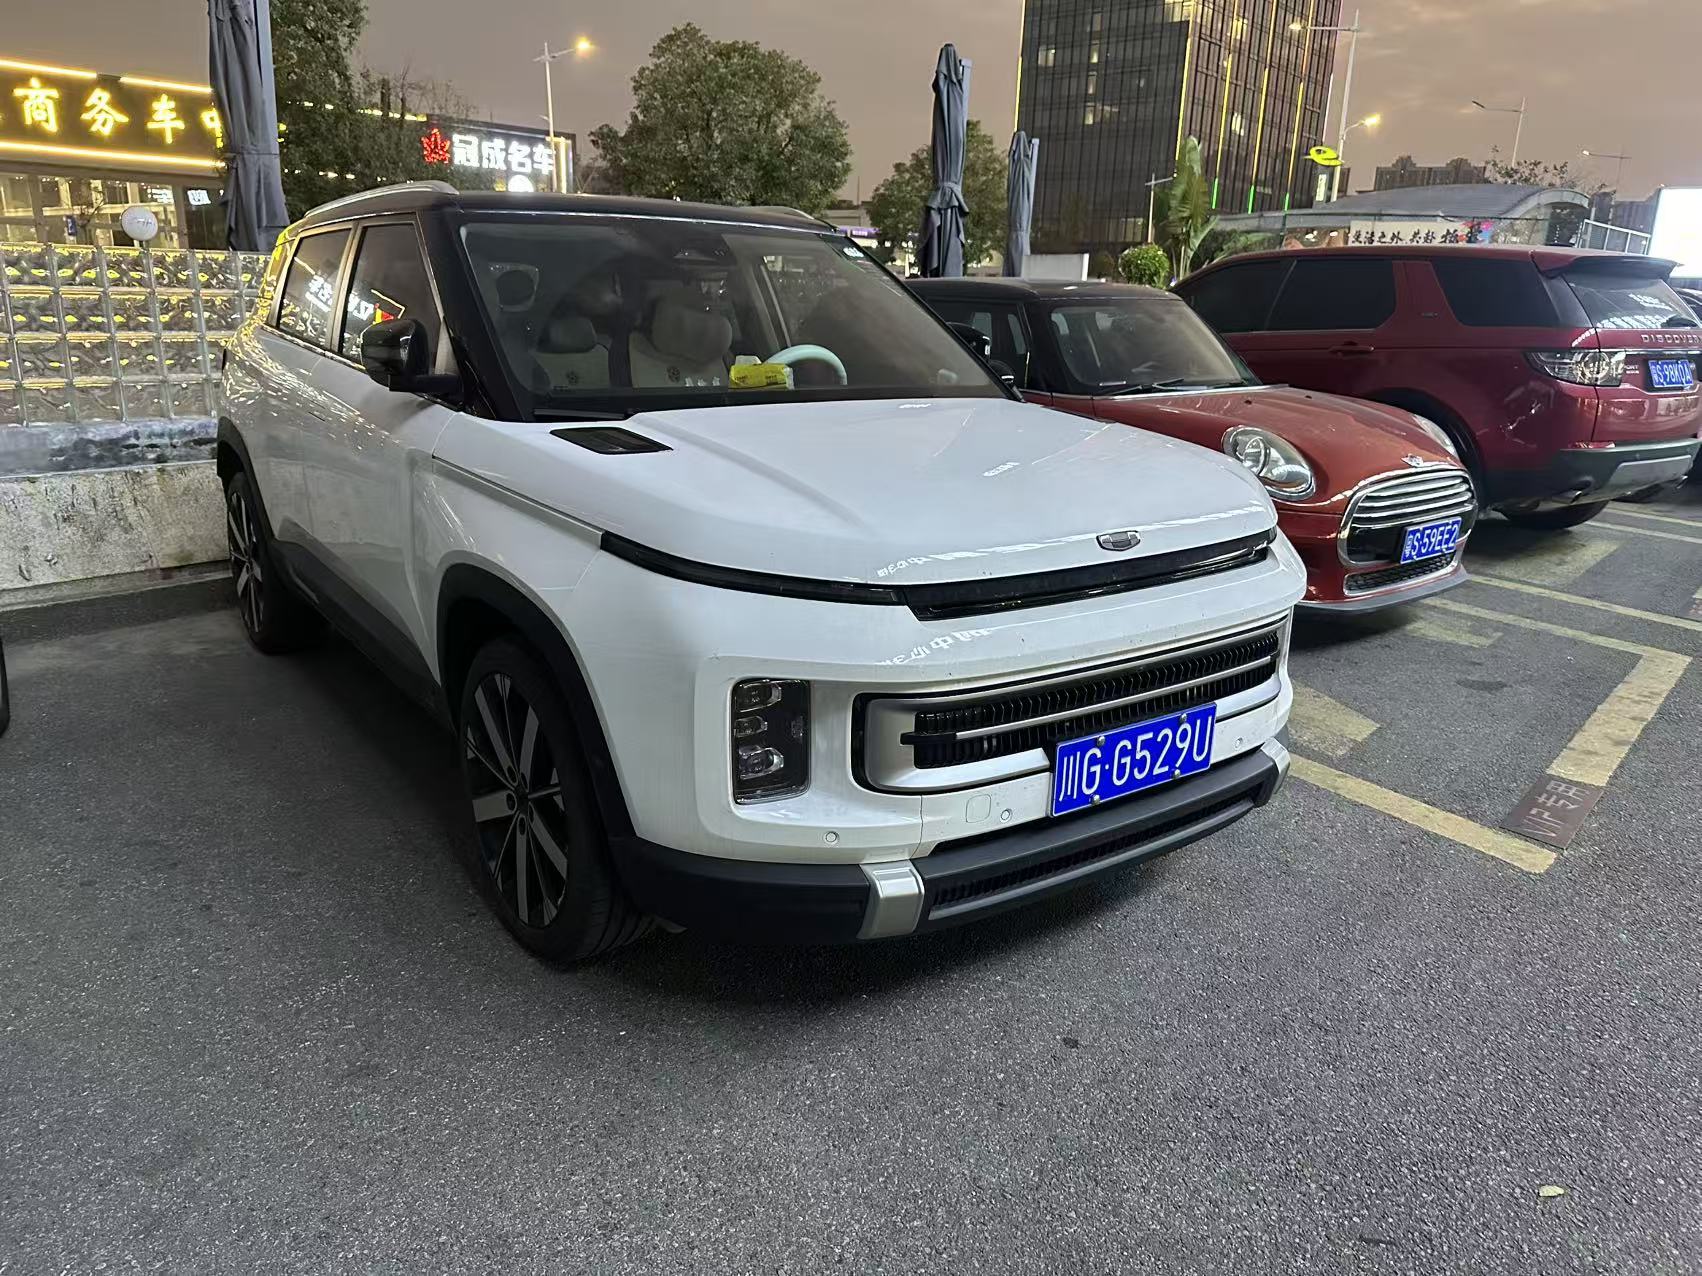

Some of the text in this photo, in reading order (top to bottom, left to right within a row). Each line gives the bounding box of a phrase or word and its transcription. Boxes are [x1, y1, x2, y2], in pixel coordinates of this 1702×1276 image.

[0, 77, 223, 148] 商务车中
[452, 133, 555, 174] 冠成名车
[1059, 715, 1213, 802] 川G·G529U
